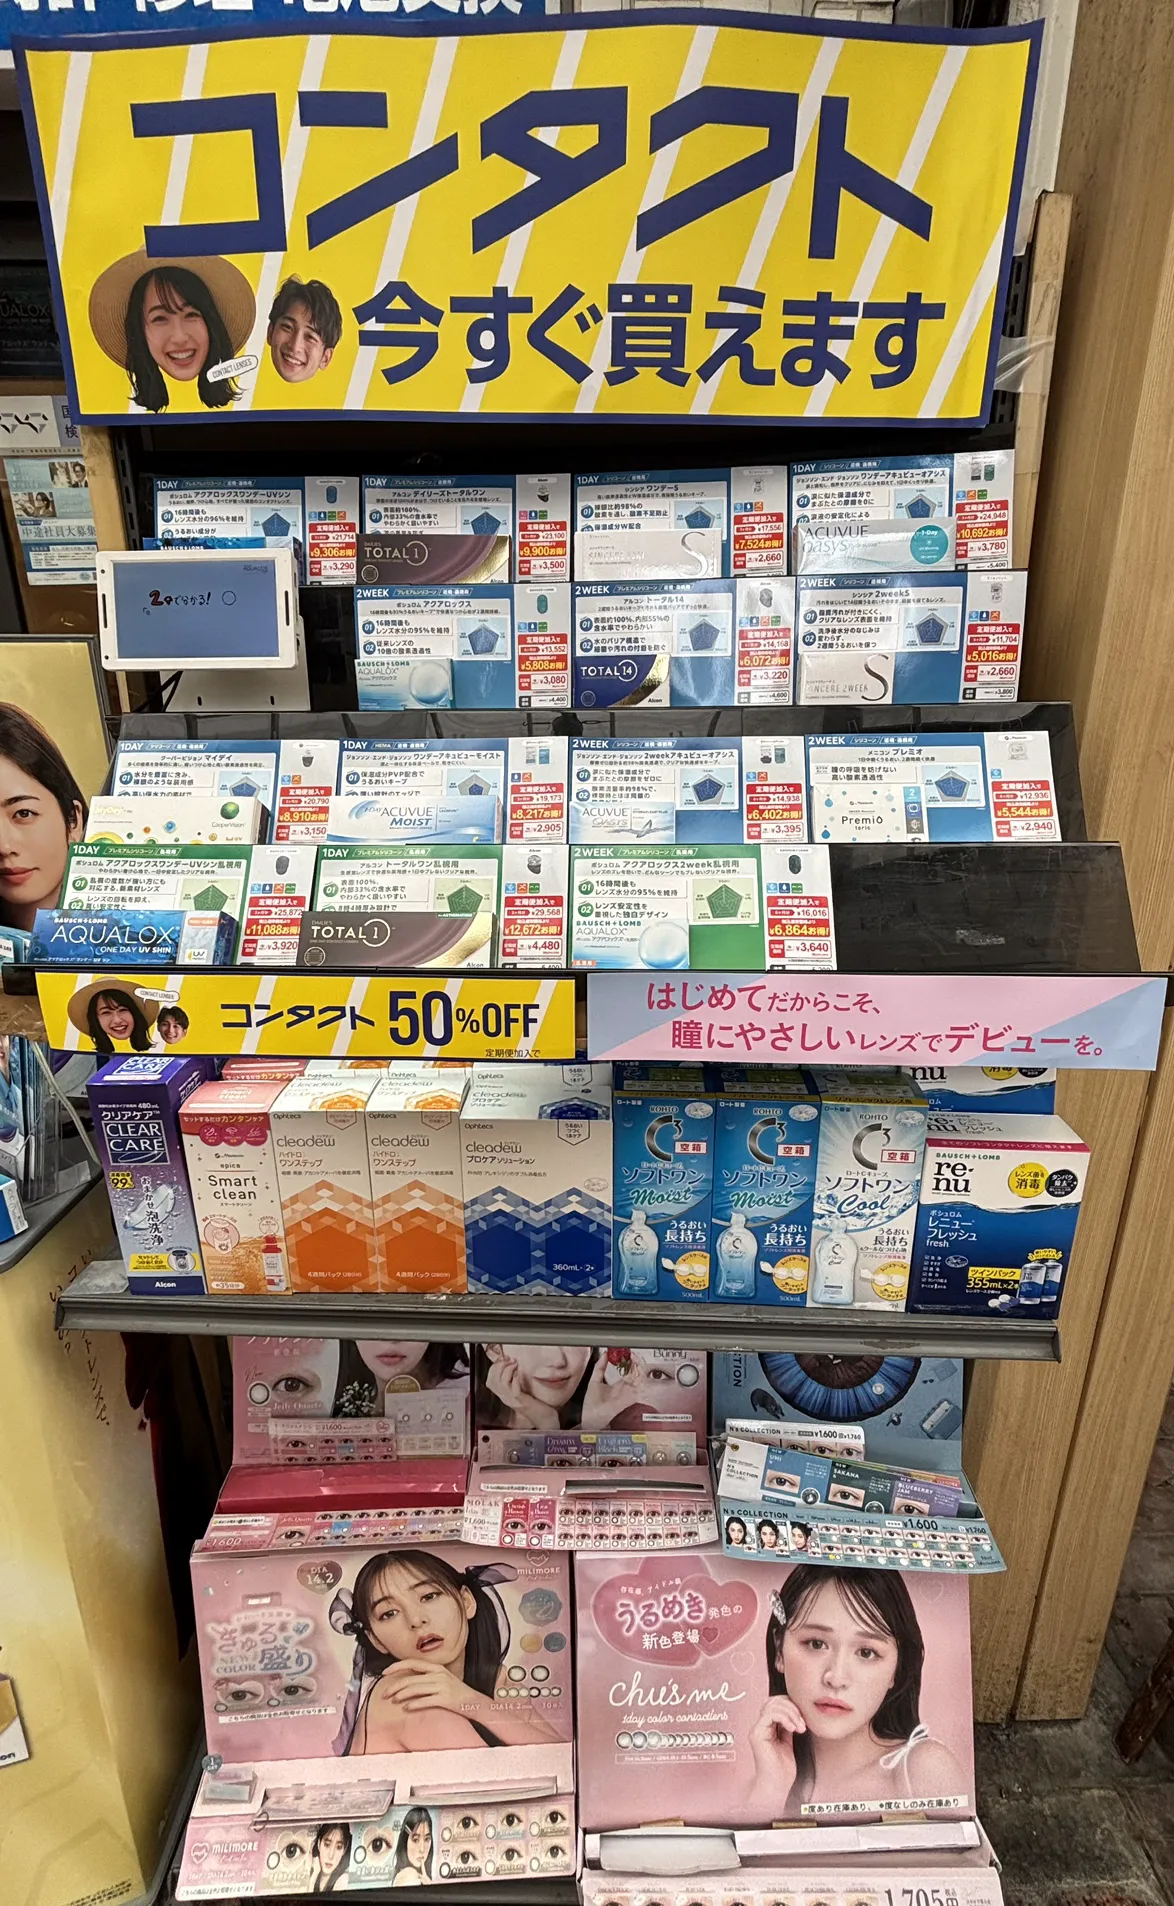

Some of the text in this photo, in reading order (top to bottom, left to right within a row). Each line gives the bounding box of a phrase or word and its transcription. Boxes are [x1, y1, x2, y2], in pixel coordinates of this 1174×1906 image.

[130, 86, 933, 259] コンタクト
[352, 281, 946, 389] 今すぐ買えます
[212, 358, 253, 379] CONTACT LENSES
[792, 464, 816, 473] 1DAY
[577, 476, 599, 484] 1DAY
[860, 470, 946, 480] ワンデーアキュビューオアシス
[157, 481, 178, 489] 1DAY
[364, 478, 387, 486] 1DAY
[413, 489, 485, 497] デイリーズトータルワン
[646, 484, 679, 492] ワンデーS
[193, 491, 291, 499] アクアロックスワンデーUVシン
[804, 525, 869, 540] ACUVUE
[802, 538, 848, 554] oasys
[977, 541, 1006, 552] ¥3,780
[364, 548, 409, 559] TOTAL
[755, 553, 782, 562] ¥2,660
[330, 562, 355, 571] ¥3,290
[539, 561, 565, 570] ¥3,500
[800, 578, 837, 587] 2WEEK
[356, 589, 390, 598] 2WEEK
[575, 585, 610, 595] 2WEEK
[875, 590, 910, 598] 2weekS
[423, 600, 472, 608] アクアロックス
[646, 596, 684, 604] トータル14
[580, 666, 633, 676] TOTAL 14
[986, 667, 1015, 676] ¥2,660
[540, 676, 566, 684] ¥3,080
[342, 740, 369, 750] 1DAY
[572, 740, 609, 749] 2WEEK
[808, 736, 846, 745] 2WEEK
[120, 743, 143, 751] 1DAY
[892, 748, 923, 756] プレミオ
[413, 752, 502, 761] ワンデーアキュビューモイスト
[644, 751, 735, 760] 2weekアキュビューオアシス
[361, 778, 408, 786] うるおいキープ
[279, 812, 329, 822] ¥8,910お得!
[380, 807, 434, 817] ACUVUE
[512, 808, 562, 819] ¥8,217お得!
[581, 807, 628, 817] ACUVUE
[748, 809, 802, 820] ¥6,402お得!
[389, 817, 433, 826] MOIST
[300, 827, 327, 836] ¥3,150
[533, 824, 562, 833] ¥2,905
[771, 824, 802, 834] ¥3,395
[1020, 822, 1053, 832] ¥2,940
[73, 845, 100, 855] 1DAY
[322, 848, 350, 858] 1DAY
[574, 848, 615, 857] 2WEEK
[105, 859, 242, 869] アクアロックスワンデーUVシン乱視用
[385, 860, 460, 869] トータルワン乱視用
[622, 860, 740, 869] アクアロックス2week乱視用
[595, 880, 637, 888] 16時間後も
[595, 888, 678, 897] レンズ水分の95%を維持
[595, 902, 648, 910] レンズ安定性を
[311, 926, 368, 939] TOTAL
[504, 923, 561, 936] ¥12,672お得!
[769, 923, 830, 936] ¥6,864お得!
[51, 925, 175, 945] AQUALOX
[100, 946, 171, 954] ONE DAY UV SHIN
[527, 941, 560, 951] ¥4,480
[796, 942, 830, 953] ¥3,640
[646, 980, 881, 1015] はじめてだからこそ、
[220, 990, 540, 1046] コンタクト 50%OFF
[671, 1020, 1104, 1058] 瞳にやさしいレンズでデビューを。
[485, 1048, 542, 1059] 定期便加入で
[910, 1067, 947, 1082] nu
[101, 1110, 153, 1120] クリアケア
[753, 1108, 783, 1116] ROHTO
[859, 1113, 889, 1121] ROHTO
[183, 1115, 265, 1123] セットするだけカンタンケア
[106, 1123, 159, 1138] CLEAR
[109, 1137, 165, 1152] CARE
[276, 1136, 336, 1148] cleadew
[371, 1136, 430, 1148] cleadew
[465, 1140, 522, 1154] cleadew
[679, 1143, 702, 1152] 空箱
[782, 1145, 805, 1155] 空箱
[466, 1155, 536, 1165] プロケアソリューション
[886, 1151, 910, 1162] 空箱
[279, 1159, 323, 1167] ワンステップ
[373, 1159, 417, 1167] ワンステップ
[622, 1166, 705, 1185] ソフトワン
[723, 1170, 807, 1188] ソフトワン
[208, 1175, 258, 1187] Smart
[825, 1175, 911, 1194] ソフトワン
[932, 1176, 971, 1194] nu
[1016, 1178, 1041, 1190] 消毒
[213, 1188, 257, 1200] clean
[630, 1187, 692, 1206] Moist
[729, 1189, 794, 1209] Moist
[836, 1194, 890, 1215] Cool
[930, 1210, 962, 1218] ボシュロム
[670, 1220, 707, 1229] うるおい
[770, 1223, 807, 1232] うるおい
[928, 1218, 973, 1228] レニュー
[664, 1230, 707, 1243] 長持ち
[878, 1227, 910, 1236] うるおい
[927, 1229, 977, 1242] フレッシュ
[763, 1233, 807, 1246] 長持ち
[872, 1236, 908, 1247] 長持ち
[926, 1239, 949, 1248] fresh
[970, 1268, 1016, 1278] ツインパック
[740, 1427, 781, 1438] COLLECTION
[833, 1469, 860, 1479] SAKANA
[897, 1483, 934, 1495] BLUEBERRY
[467, 1499, 500, 1507] MOLAK
[736, 1508, 789, 1520] COLLECTION
[902, 1519, 938, 1532] ¥1,600
[310, 1565, 329, 1574] DIA
[306, 1573, 334, 1586] 14.2
[617, 1591, 743, 1635] うるめき 発色の
[641, 1629, 700, 1650] 新色登場
[608, 1671, 746, 1706] chu's me
[621, 1711, 645, 1728] 1day
[647, 1711, 675, 1723] color
[808, 1797, 959, 1814] 度あり在庫あり、 度なしのみ在庫あり
[212, 1841, 259, 1854] MILIMORE
